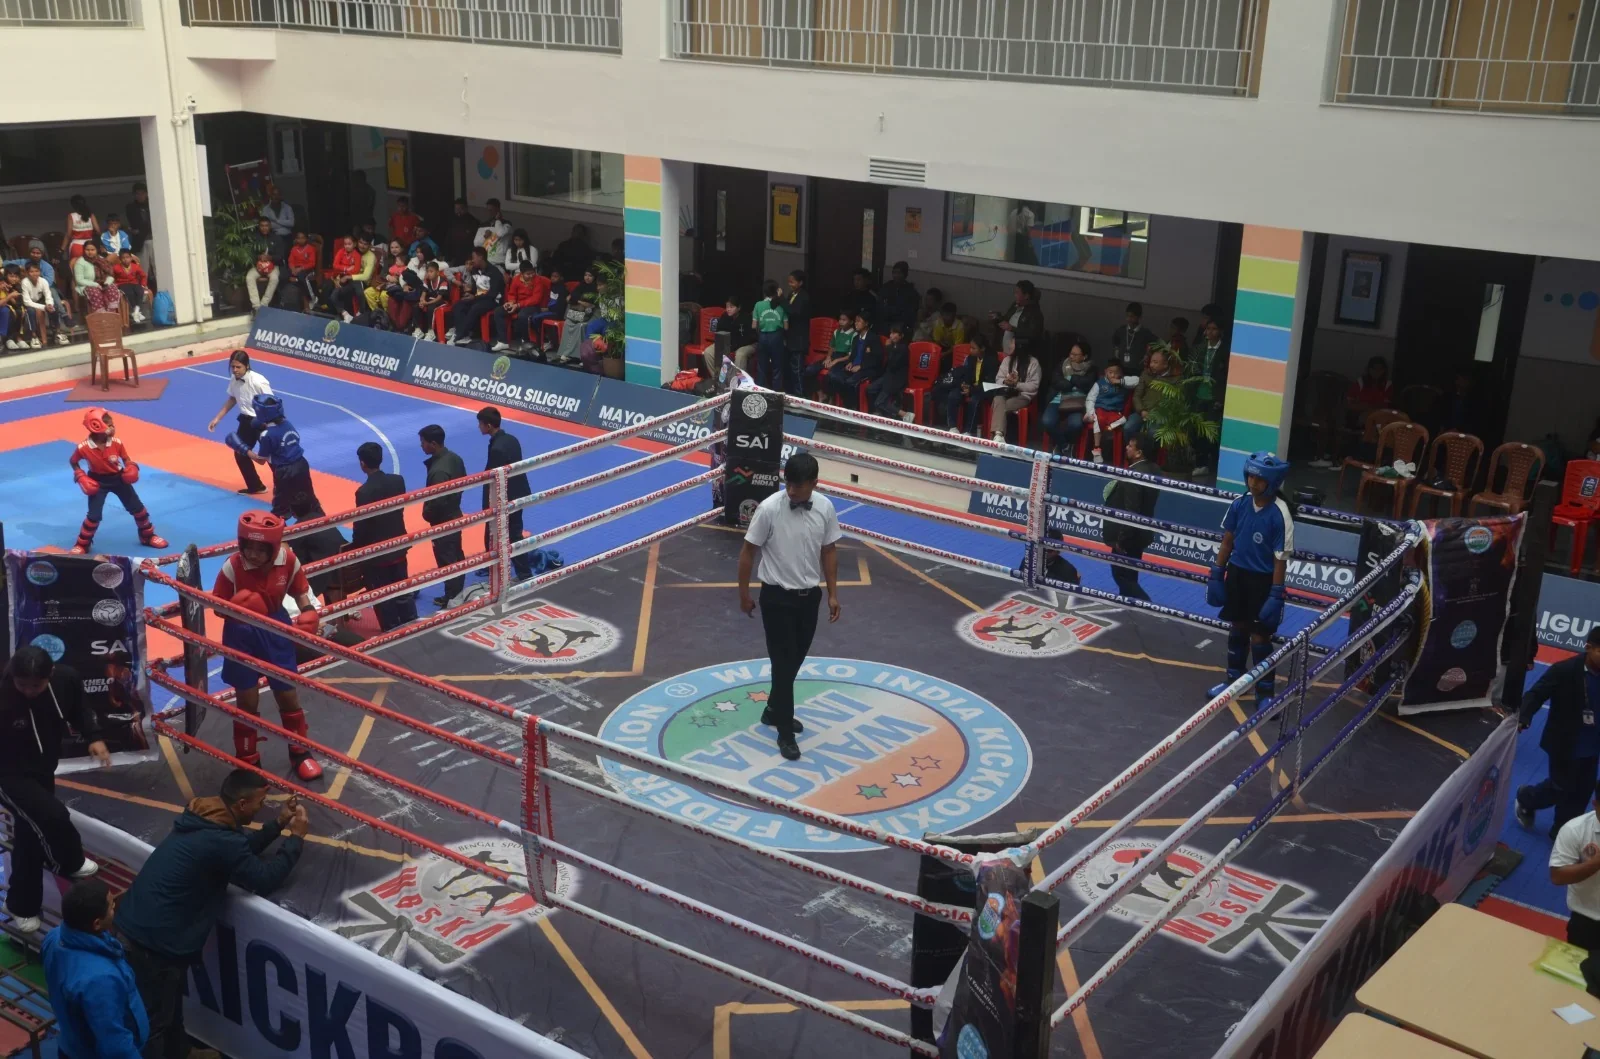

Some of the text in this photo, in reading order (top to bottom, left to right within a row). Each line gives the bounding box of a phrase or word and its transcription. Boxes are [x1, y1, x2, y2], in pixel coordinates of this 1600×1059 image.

[254, 328, 400, 371] MAYOOR SCHOOL SILIGURI
[412, 364, 581, 412] MAYOOR SCHOOL SILIGURI
[420, 379, 457, 393] COLLABORATION
[457, 388, 470, 396] WITH
[469, 390, 486, 399] MAYO
[485, 393, 506, 404] COLLEGE
[506, 398, 529, 409] GENERAL
[552, 409, 570, 418] AJMER
[542, 448, 569, 461] WEST
[571, 436, 609, 453] BENGAL
[611, 424, 648, 439] SPORTS
[648, 405, 700, 427] KICKBOXING
[653, 431, 668, 440] WITH
[668, 434, 686, 444] MAYO
[736, 433, 769, 450] SAI
[810, 402, 999, 449] SPORTS KICKBOXING ASSOCIATION
[544, 485, 571, 498] WEST
[573, 472, 609, 489] BENGAL
[613, 458, 649, 474] SPORTS
[649, 440, 701, 462] KICKBOXING
[751, 479, 774, 487] INDIA
[753, 473, 779, 482] KHELO
[814, 443, 855, 457] SPORTS
[857, 453, 925, 474] KICKBOXING
[928, 469, 1007, 492] ASSOCIATION
[1033, 461, 1041, 482] WEST
[1068, 457, 1216, 495] WEST BENGAL SPORTS
[329, 497, 405, 522] KICKBOXING
[408, 475, 484, 501] ASSOCIATION
[541, 525, 568, 540] WEST
[571, 512, 608, 530] BENGAL
[609, 499, 644, 515] SPORTS
[646, 478, 699, 502] KICKBOXING
[1030, 482, 1038, 509] BENGAL
[333, 513, 487, 563] KICKBOXING ASSOCIATION
[1055, 520, 1073, 532] WITH
[1075, 524, 1098, 536] MAYO
[1170, 546, 1207, 563] COUNCIL,
[1076, 501, 1222, 541] WEST BENGAL SPORTS
[536, 573, 563, 585] WEST
[566, 558, 601, 576] BENGAL
[604, 543, 640, 560] SPORTS
[640, 521, 694, 547] KICKBOXING
[903, 540, 977, 566] ASSOCIATION
[333, 555, 484, 612] KICKBOXING ASSOCIATION
[1044, 576, 1079, 591] WEST
[1081, 585, 1130, 604] BENGAL
[1135, 598, 1186, 617] SPORTS
[1285, 575, 1295, 583] IN
[404, 604, 478, 632] ASSOCIATION
[464, 605, 579, 648] WBSKA
[992, 600, 1102, 642] WBSKA
[1271, 642, 1292, 662] WEST
[1320, 597, 1345, 622] SPORTS
[1344, 563, 1383, 601] KICKBOXING
[872, 671, 985, 722] INDIA
[749, 714, 932, 800] WAKO
[1070, 789, 1112, 826] SPORTS
[1112, 741, 1174, 792] KICKBOXING
[1174, 692, 1232, 742] ASSOCIATION
[756, 796, 878, 840] KICKBOXING
[370, 865, 512, 950] WBSKA
[1161, 864, 1279, 945] WBSKA
[730, 920, 846, 973] KICKBOXING
[1063, 977, 1104, 1017] SPORTS
[1106, 917, 1164, 979] KICKBOXING
[1166, 860, 1222, 917] ASSOCIATION
